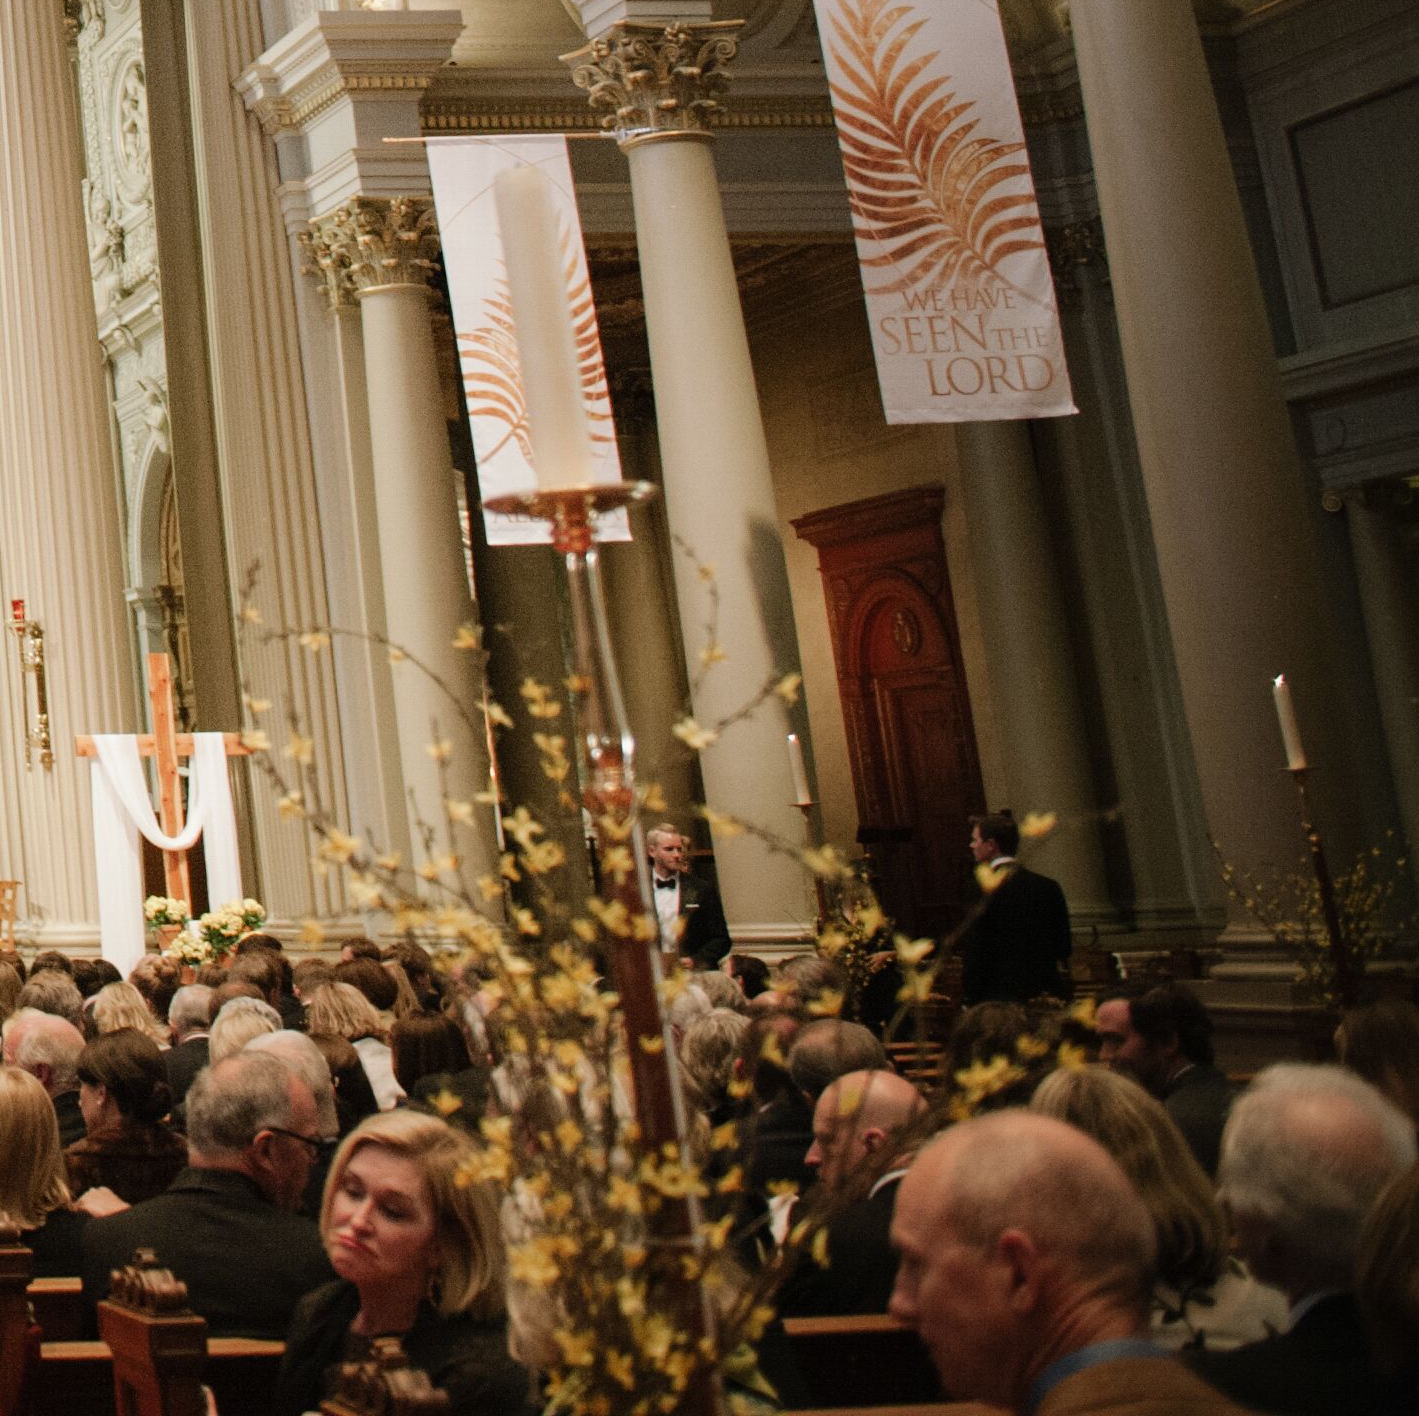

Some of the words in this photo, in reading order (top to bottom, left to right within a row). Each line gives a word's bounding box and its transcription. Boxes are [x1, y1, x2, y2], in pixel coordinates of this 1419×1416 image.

[901, 290, 945, 312] WE
[951, 287, 1016, 311] HAVE
[880, 314, 990, 356] SEEN
[991, 326, 1051, 351] THE
[924, 353, 1056, 397] LORD
